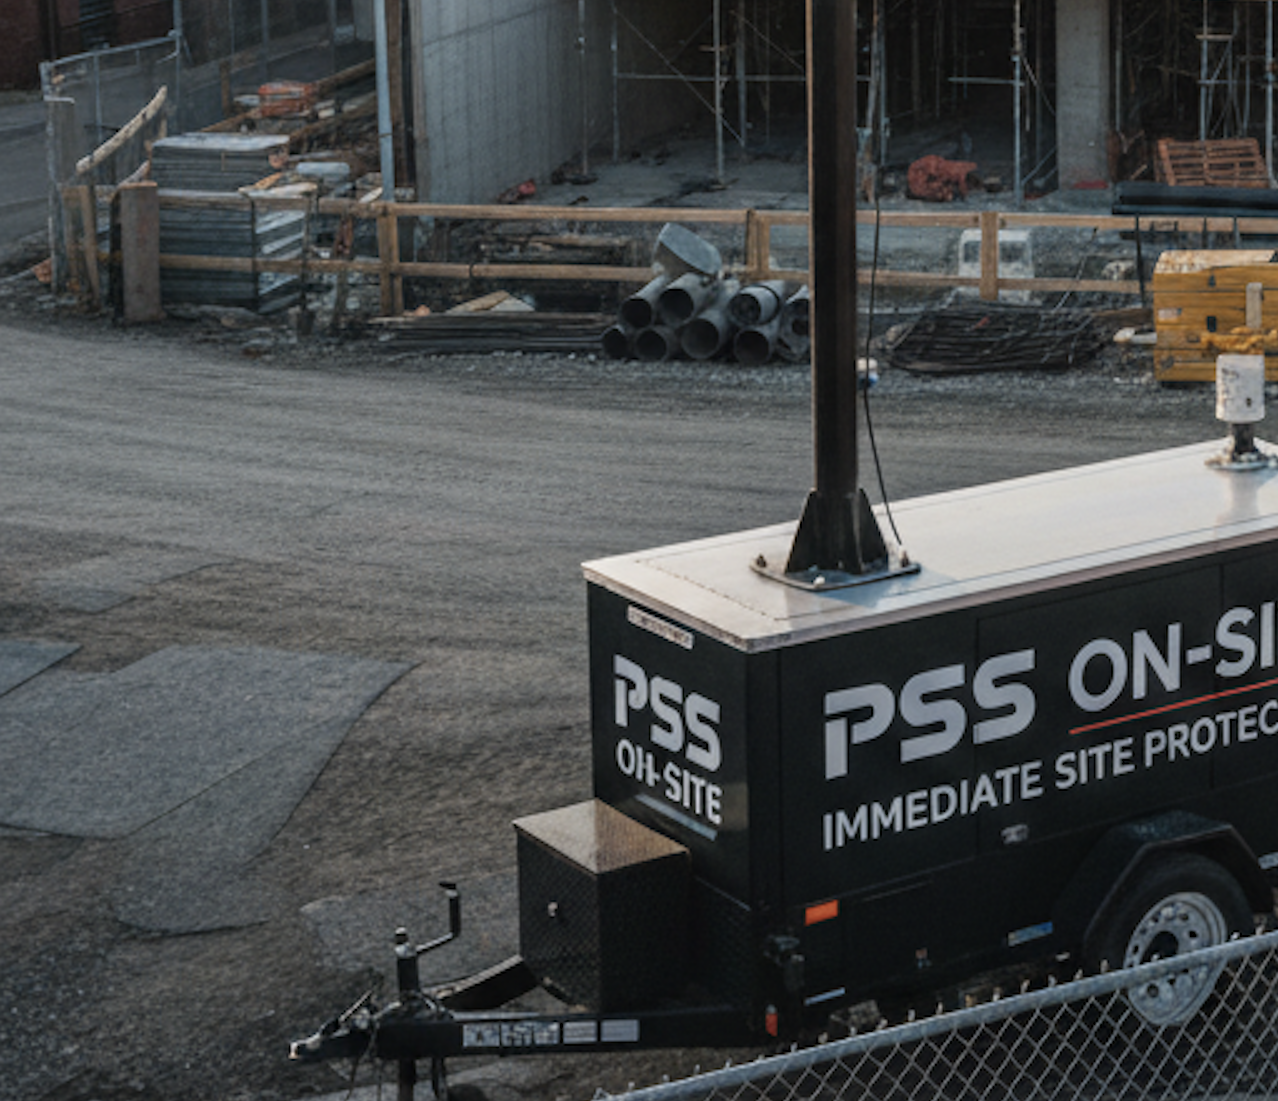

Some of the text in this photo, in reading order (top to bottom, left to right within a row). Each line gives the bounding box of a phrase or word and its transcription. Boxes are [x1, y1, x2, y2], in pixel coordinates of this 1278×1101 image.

[614, 654, 721, 772] PSS
[825, 648, 1036, 780] PSS
[823, 760, 1044, 850] IMMEDIATE
[1054, 737, 1135, 789] SITE
